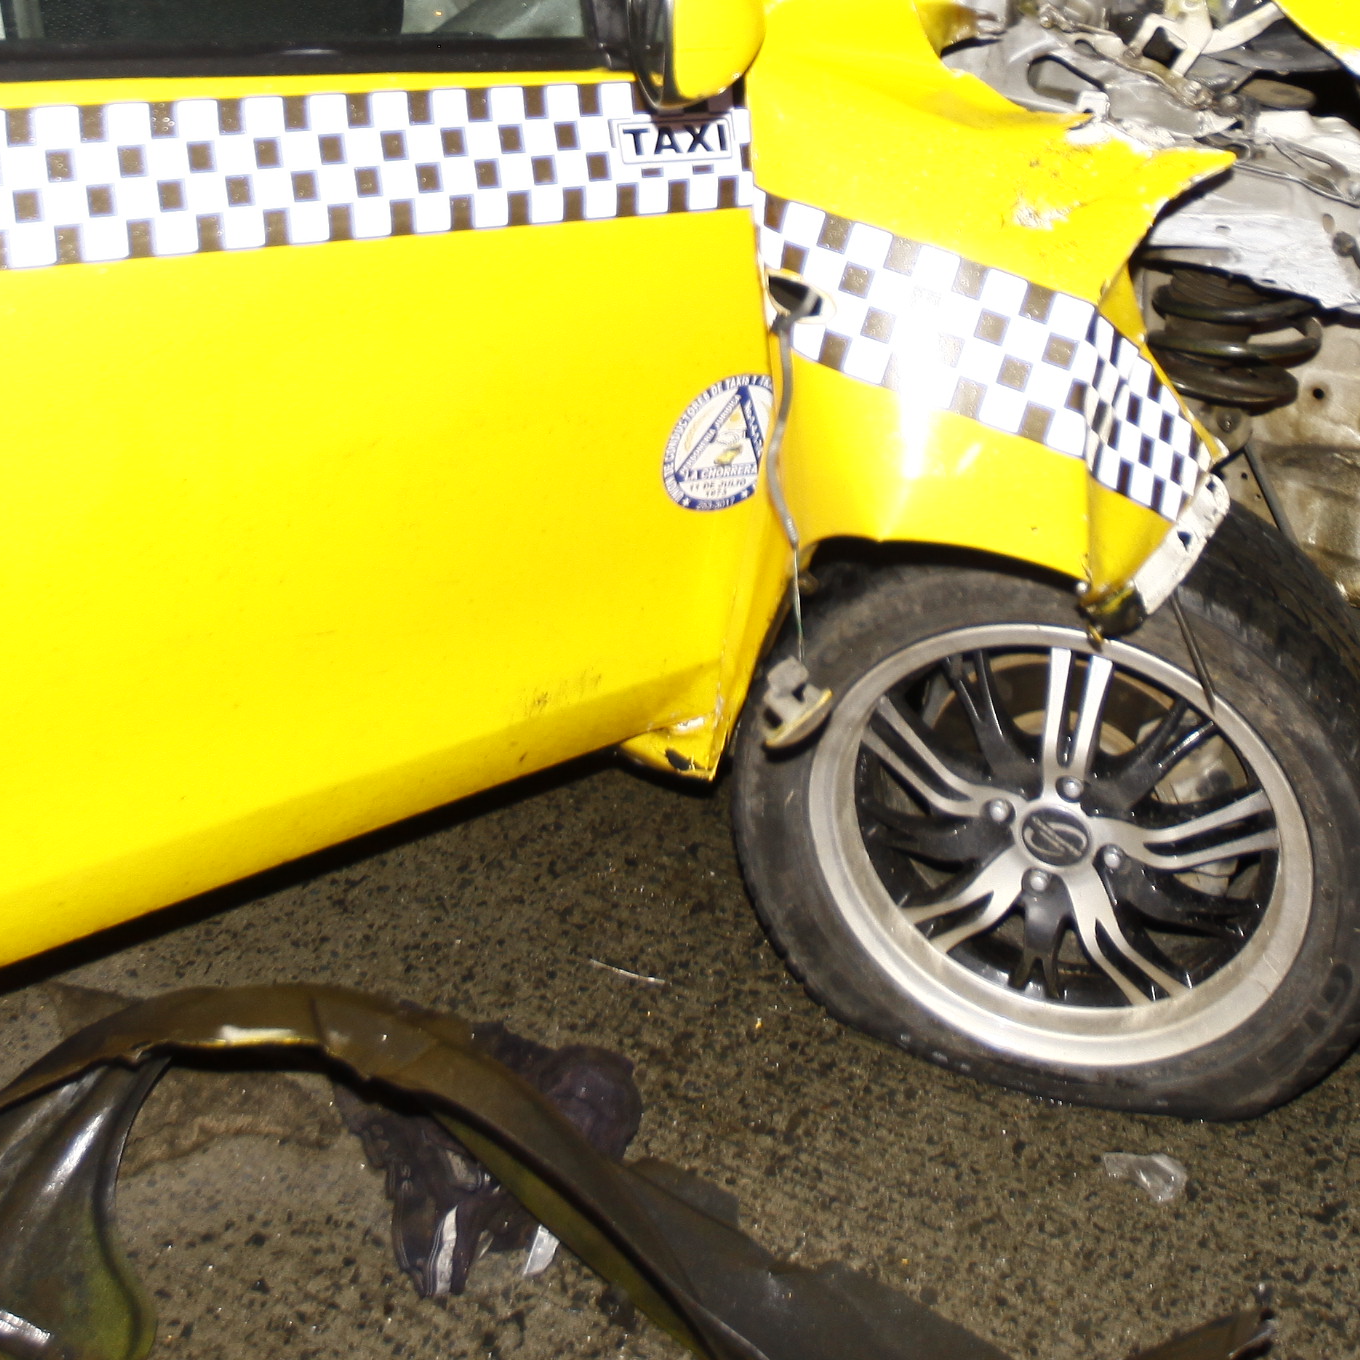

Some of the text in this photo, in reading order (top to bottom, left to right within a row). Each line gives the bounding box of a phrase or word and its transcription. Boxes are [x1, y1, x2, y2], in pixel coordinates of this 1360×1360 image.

[623, 124, 729, 156] TAXI
[686, 462, 758, 481] LA CHORRERA
